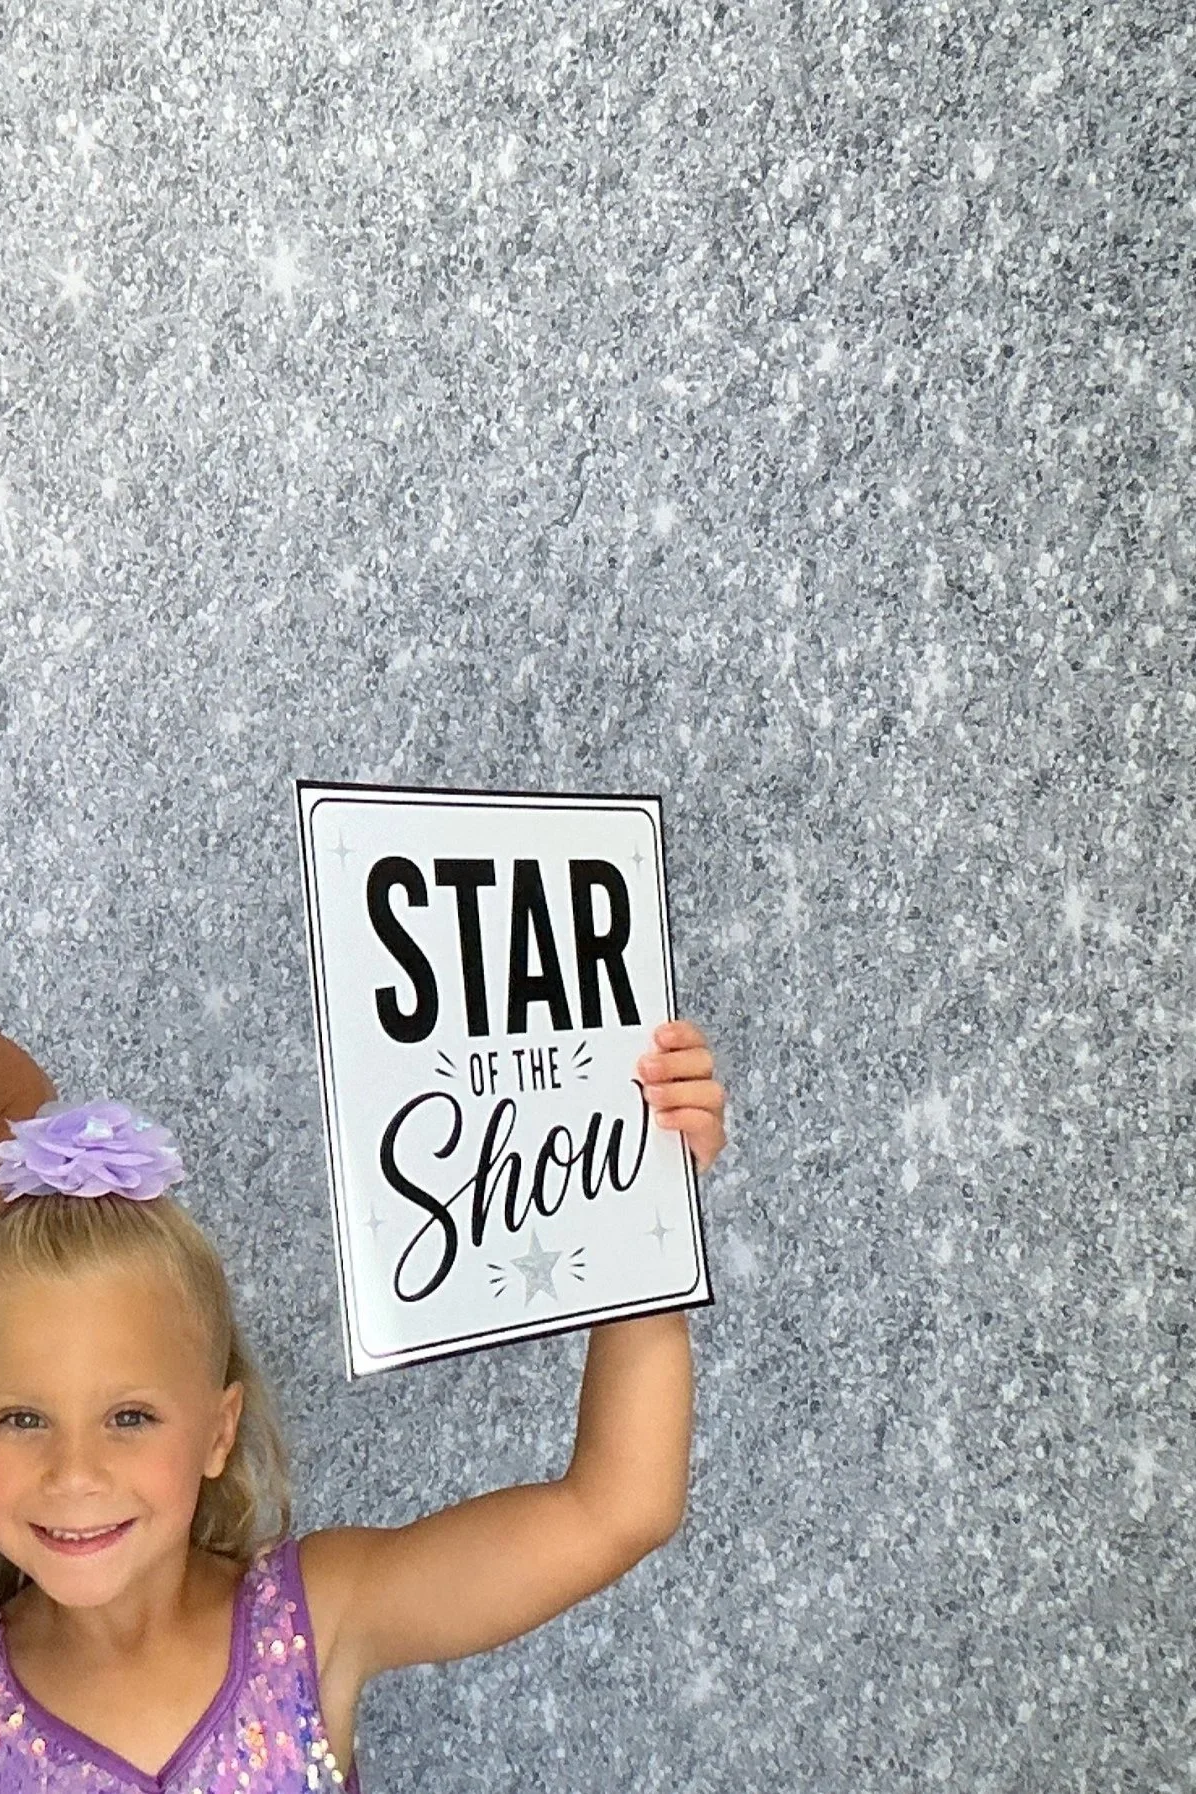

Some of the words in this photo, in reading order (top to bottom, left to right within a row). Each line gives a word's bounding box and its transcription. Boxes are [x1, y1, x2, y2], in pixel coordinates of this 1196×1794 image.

[366, 856, 642, 1043] STAR
[470, 1051, 499, 1097] OF
[512, 1047, 563, 1092] THE
[379, 1078, 650, 1302] Show
